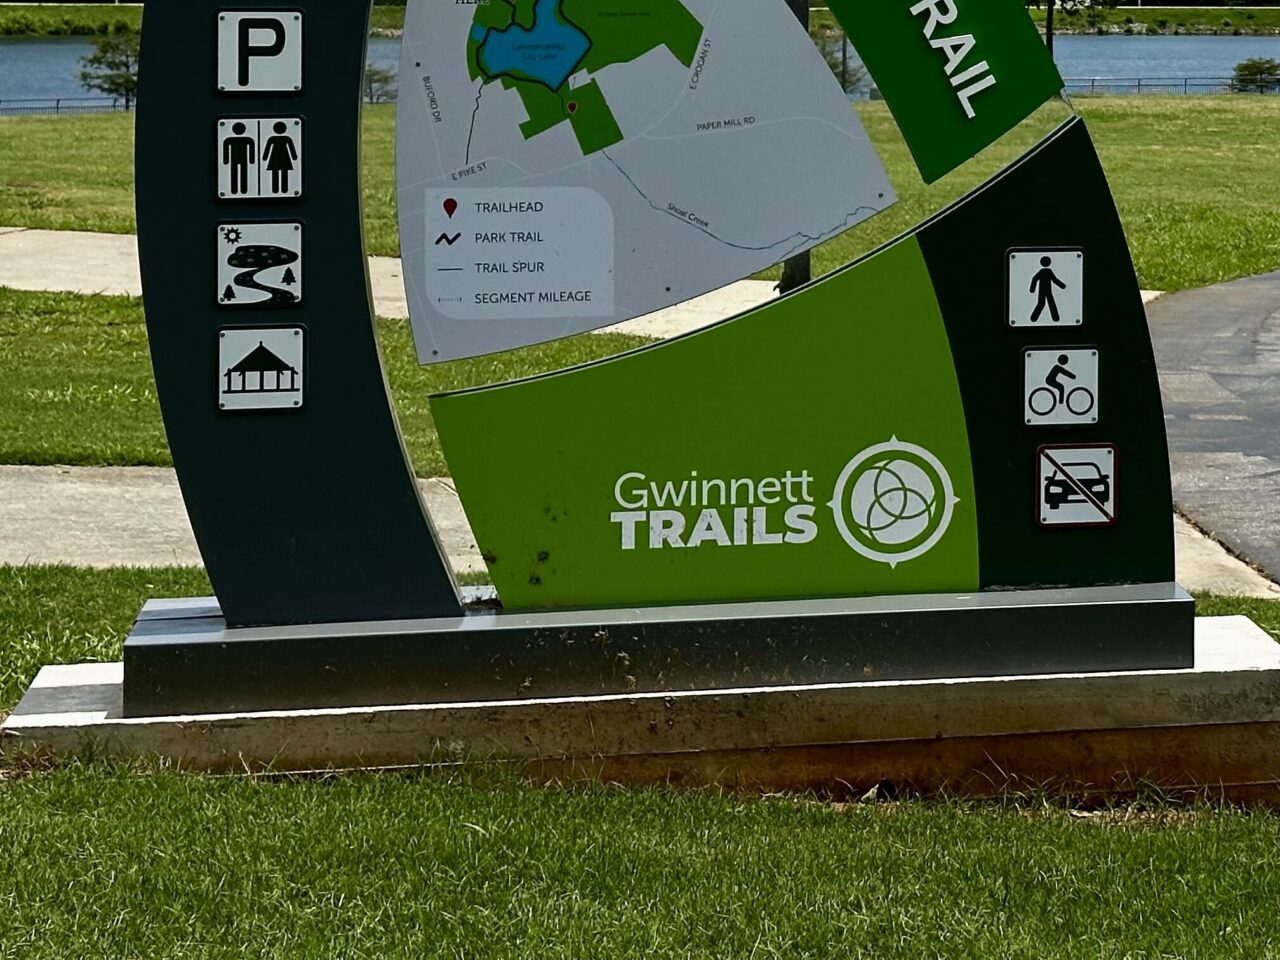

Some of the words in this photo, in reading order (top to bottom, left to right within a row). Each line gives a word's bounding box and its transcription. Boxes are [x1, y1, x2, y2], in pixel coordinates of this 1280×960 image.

[237, 17, 286, 87] P
[696, 120, 722, 130] PAPER
[723, 118, 741, 127] MILL
[743, 116, 756, 125] RD
[476, 161, 488, 172] ST
[474, 201, 544, 213] TRAILHEAD
[475, 232, 507, 243] PARK
[508, 231, 544, 242] TRAIL
[474, 262, 509, 273] TRAIL
[511, 261, 545, 273] SPUR
[474, 292, 535, 304] SEGMENT
[538, 290, 593, 303] MILEAGE
[614, 469, 814, 509] Gwinnett
[610, 504, 818, 550] TRAILS
